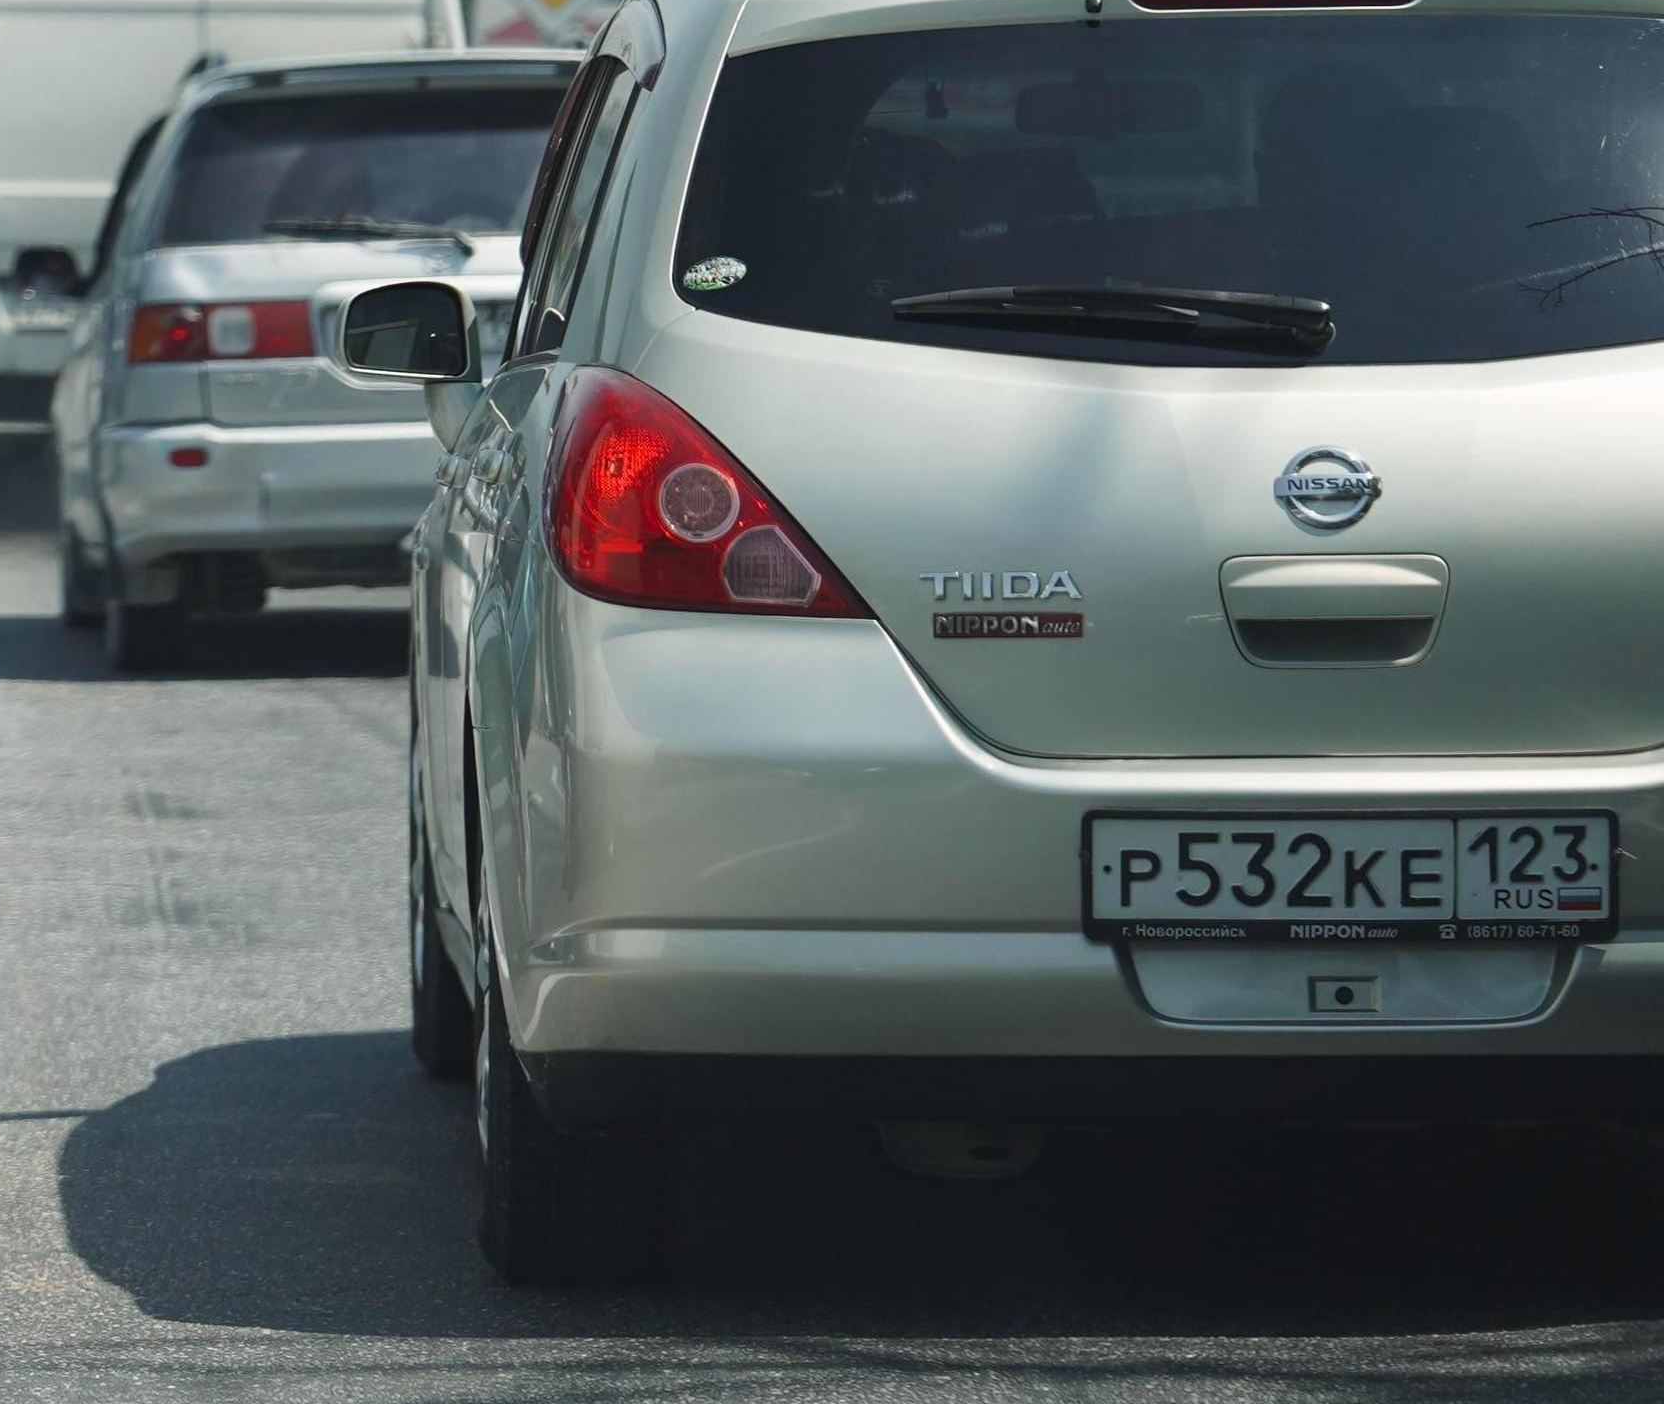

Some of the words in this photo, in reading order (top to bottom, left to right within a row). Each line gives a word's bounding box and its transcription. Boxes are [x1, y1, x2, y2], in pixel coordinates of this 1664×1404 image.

[1287, 477, 1372, 491] NISSAN
[919, 570, 1083, 600] TIIDA
[935, 615, 1039, 634] NIPPON
[1042, 621, 1081, 634] auto
[1121, 832, 1442, 907] Р532КЕ
[1468, 825, 1587, 884] 123
[1495, 888, 1554, 909] RUS
[1136, 924, 1247, 941] Новороссийск
[1290, 925, 1365, 938] NIPPON
[1368, 928, 1400, 939] auto
[1468, 924, 1513, 940] (8617)
